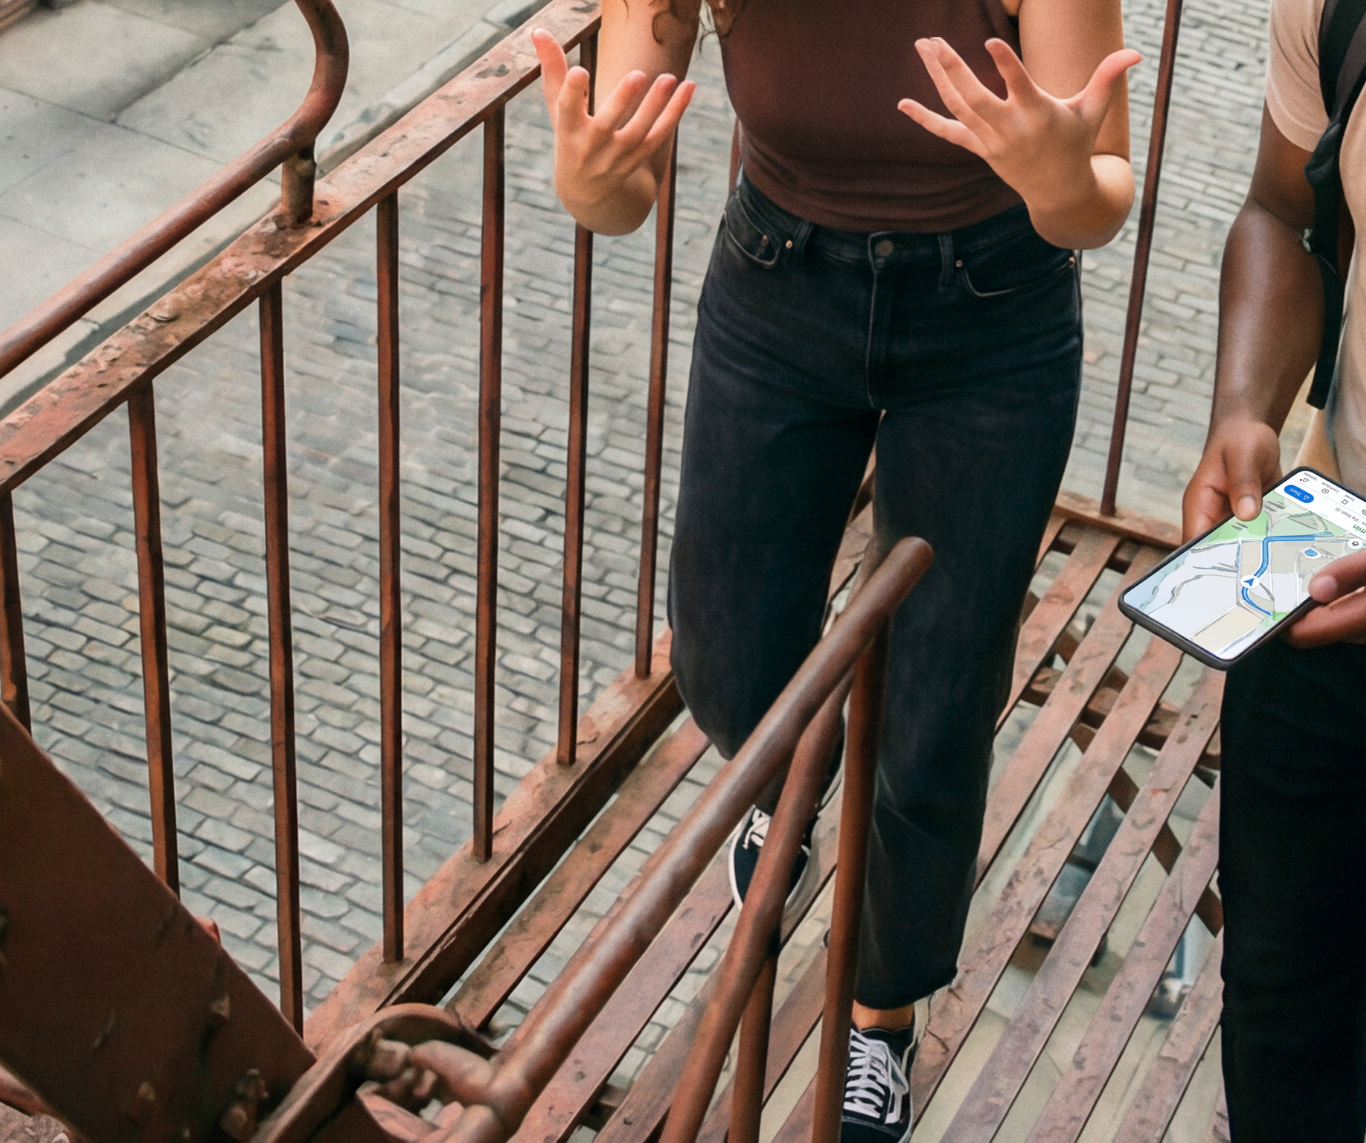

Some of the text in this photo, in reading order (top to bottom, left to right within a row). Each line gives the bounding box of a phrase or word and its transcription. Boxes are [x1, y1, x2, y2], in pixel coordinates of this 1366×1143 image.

[1289, 488, 1302, 496] Start
[1340, 510, 1352, 518] Main
[1353, 524, 1366, 534] min
